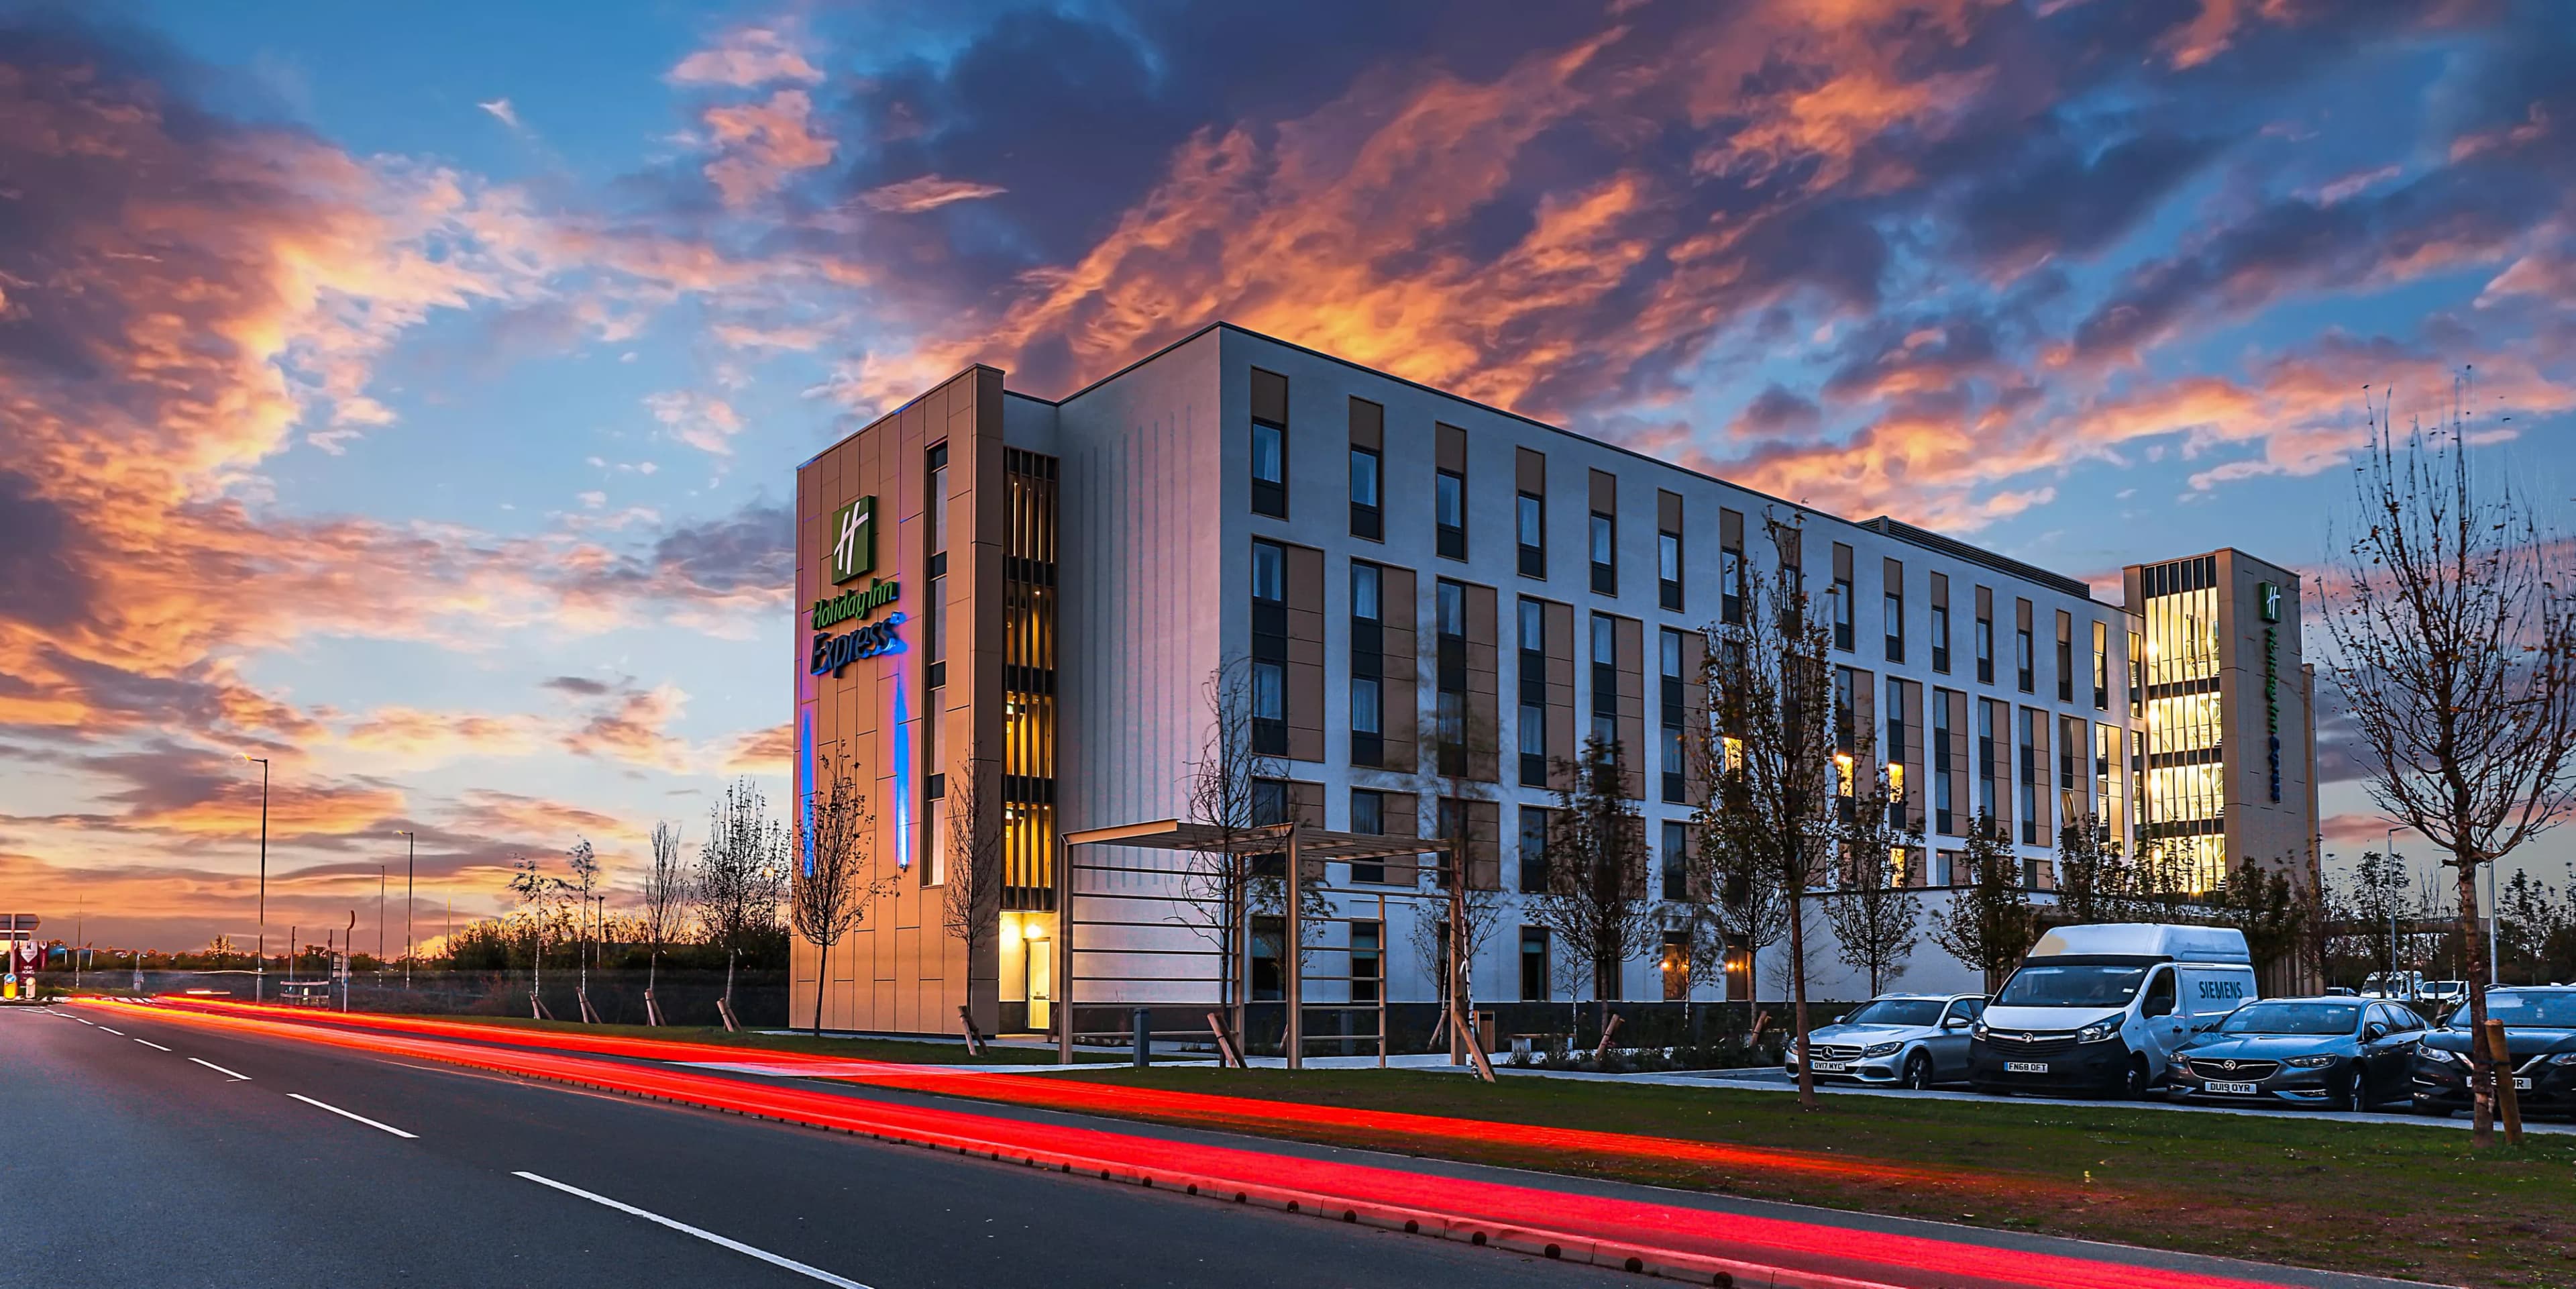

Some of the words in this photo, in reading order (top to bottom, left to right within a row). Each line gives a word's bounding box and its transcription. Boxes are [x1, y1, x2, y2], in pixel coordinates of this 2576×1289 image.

[812, 589, 867, 630] Holiday
[867, 578, 900, 609] Inn
[810, 612, 902, 679] Express
[2199, 981, 2243, 999] SIEMENS
[2008, 1063, 2029, 1071] FN68
[2210, 1082, 2230, 1091] DU19
[2231, 1084, 2250, 1092] OYR
